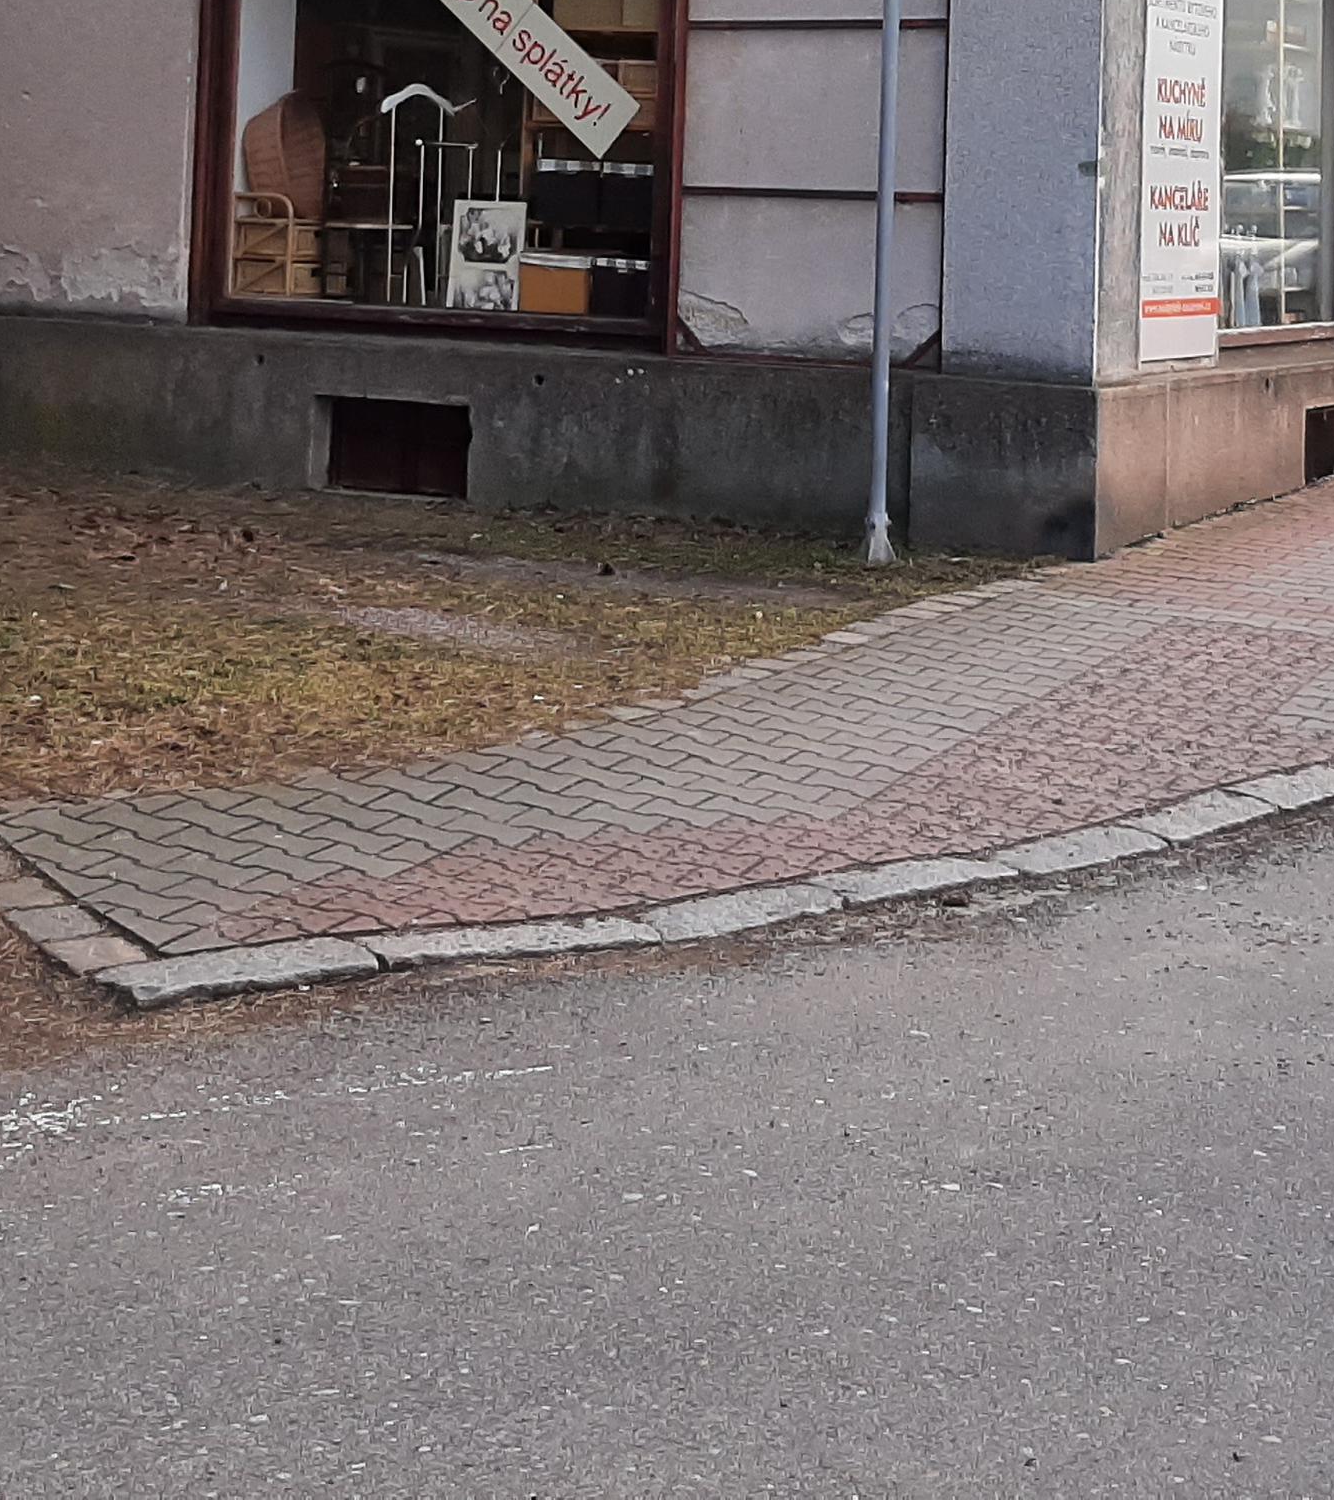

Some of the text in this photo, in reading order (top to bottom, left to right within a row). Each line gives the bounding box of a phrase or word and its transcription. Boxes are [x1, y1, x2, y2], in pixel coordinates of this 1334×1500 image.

[512, 29, 611, 126] splátky!
[1158, 109, 1203, 143] NA MÍRU
[1158, 216, 1200, 247] NA KLÍČ
